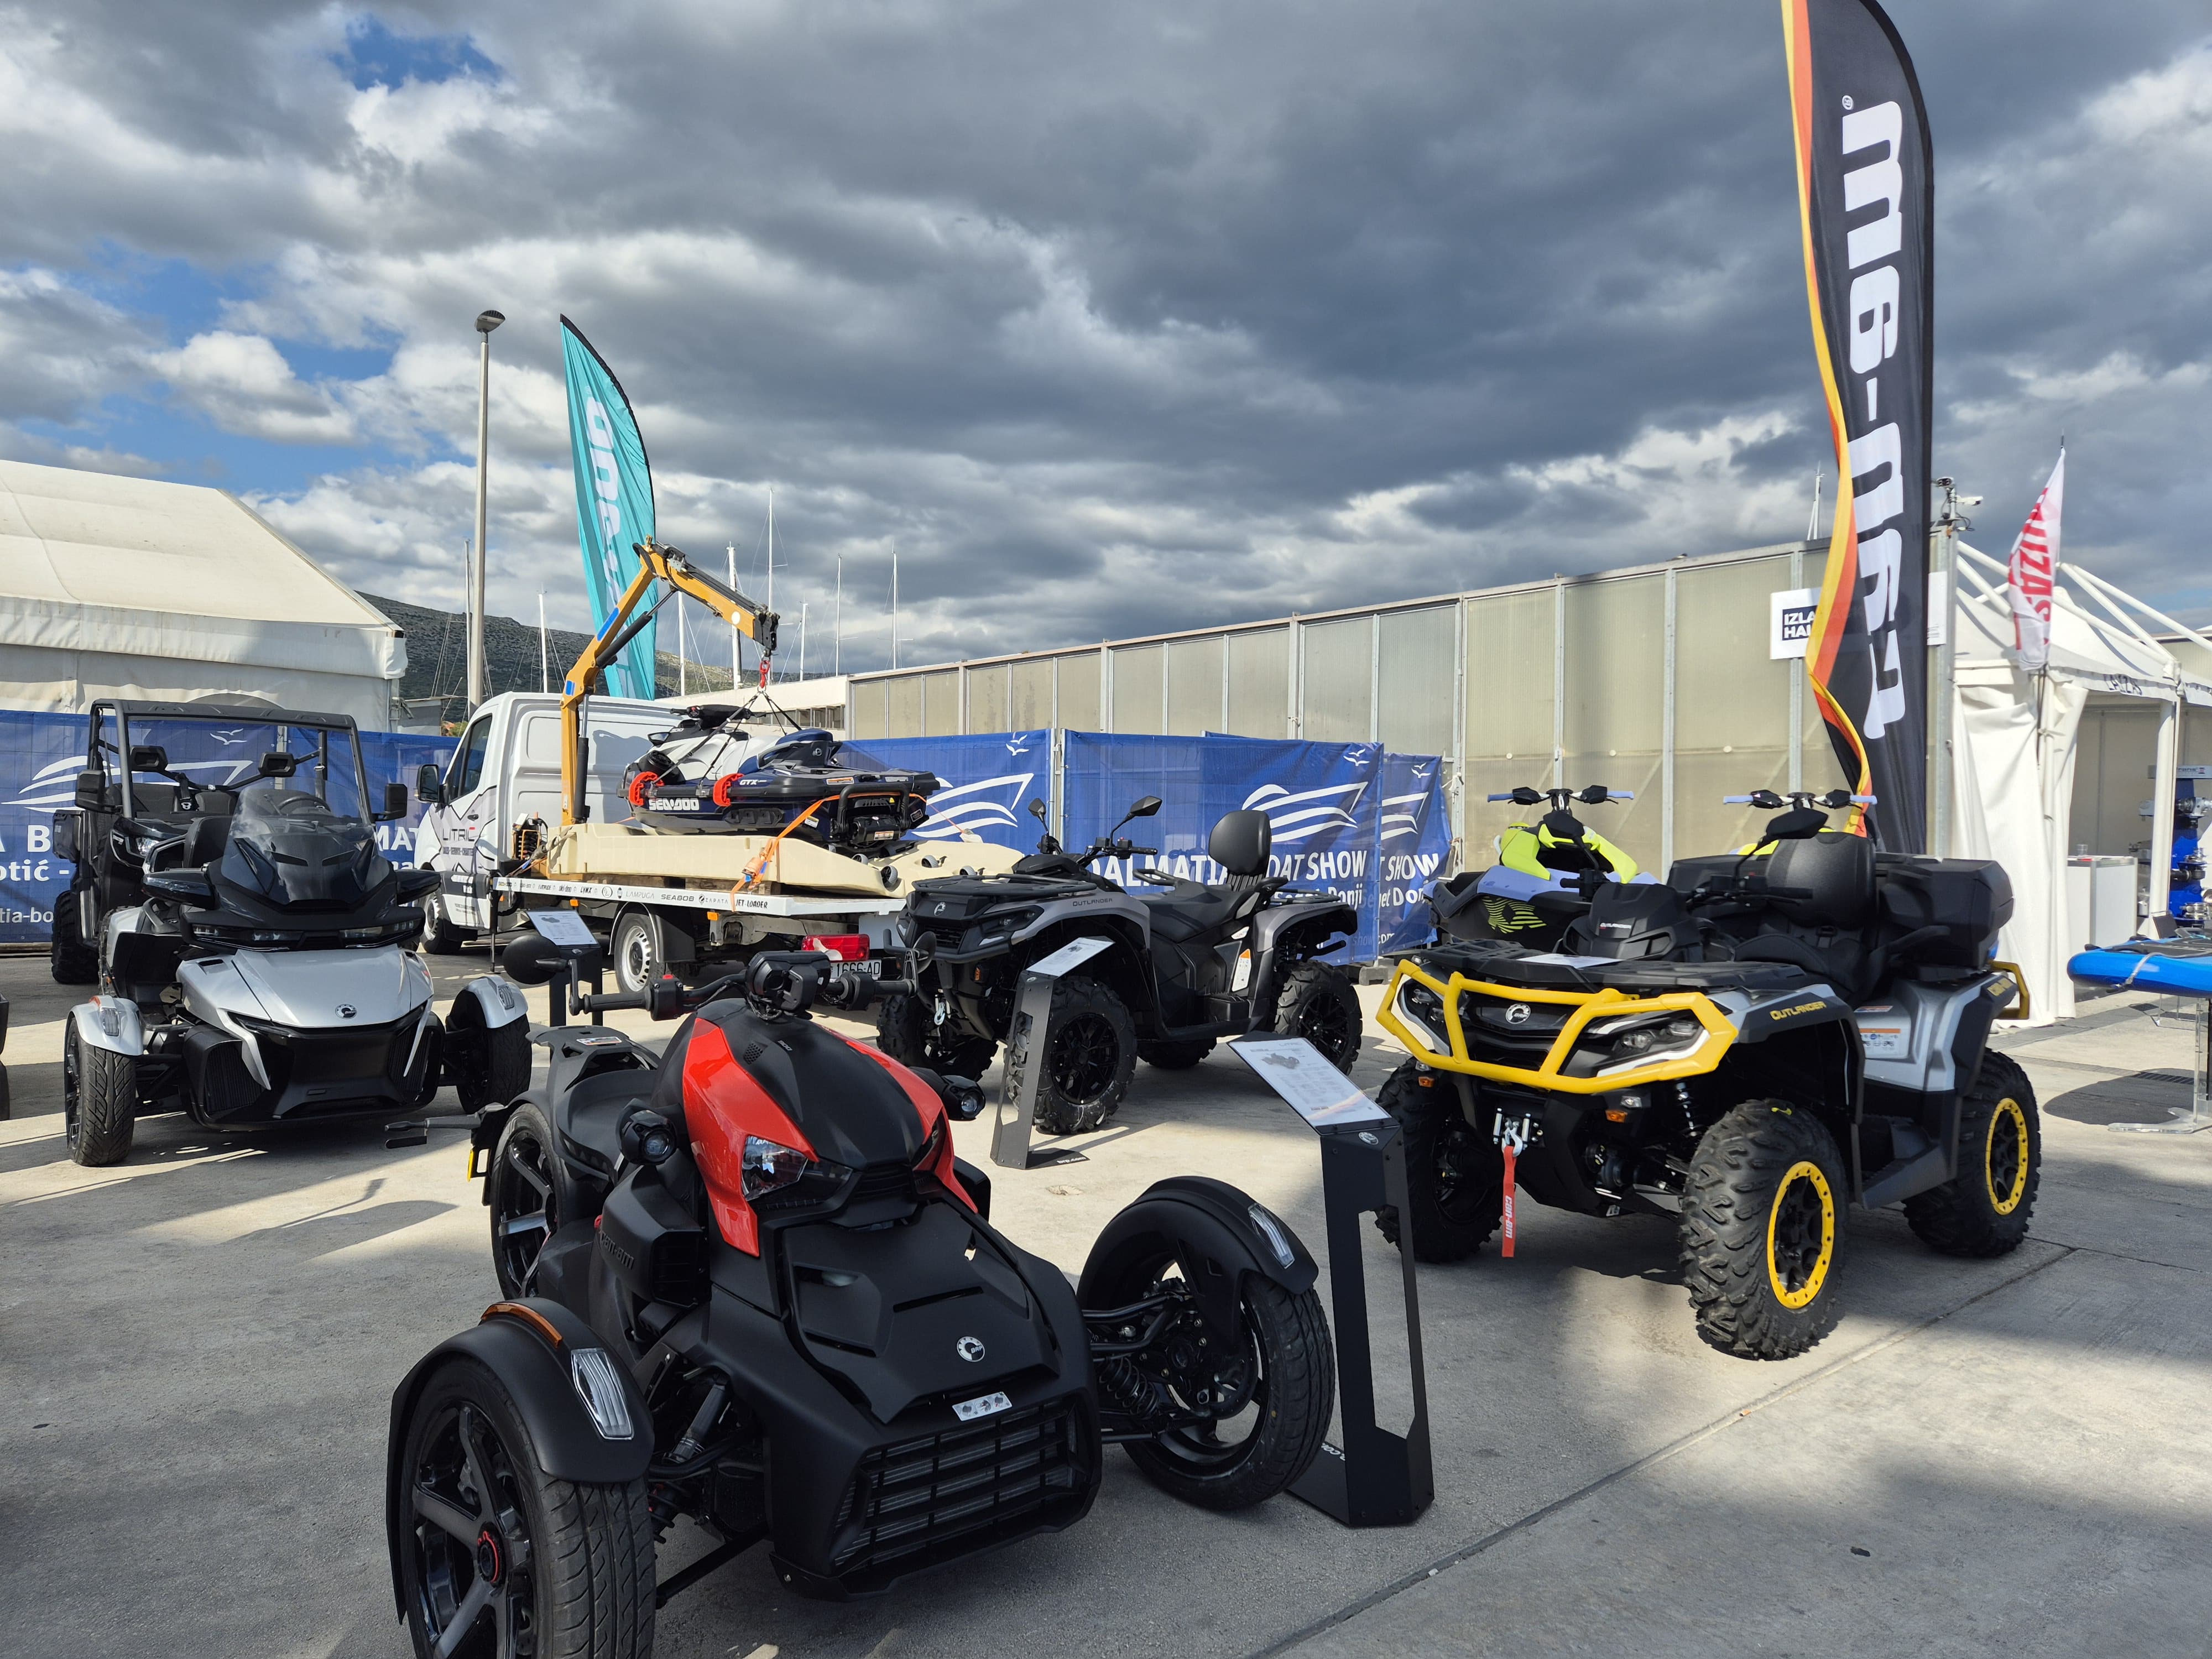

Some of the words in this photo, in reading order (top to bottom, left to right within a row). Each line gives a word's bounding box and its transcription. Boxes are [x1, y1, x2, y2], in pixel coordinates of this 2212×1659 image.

[1266, 854, 1305, 881] OAT
[1306, 850, 1367, 881] SHOW
[1385, 853, 1439, 881] SHOW
[1073, 898, 1113, 906] OUTLANDER
[1770, 1001, 1827, 1021] OUTLANDER
[971, 1345, 983, 1354] BRP
